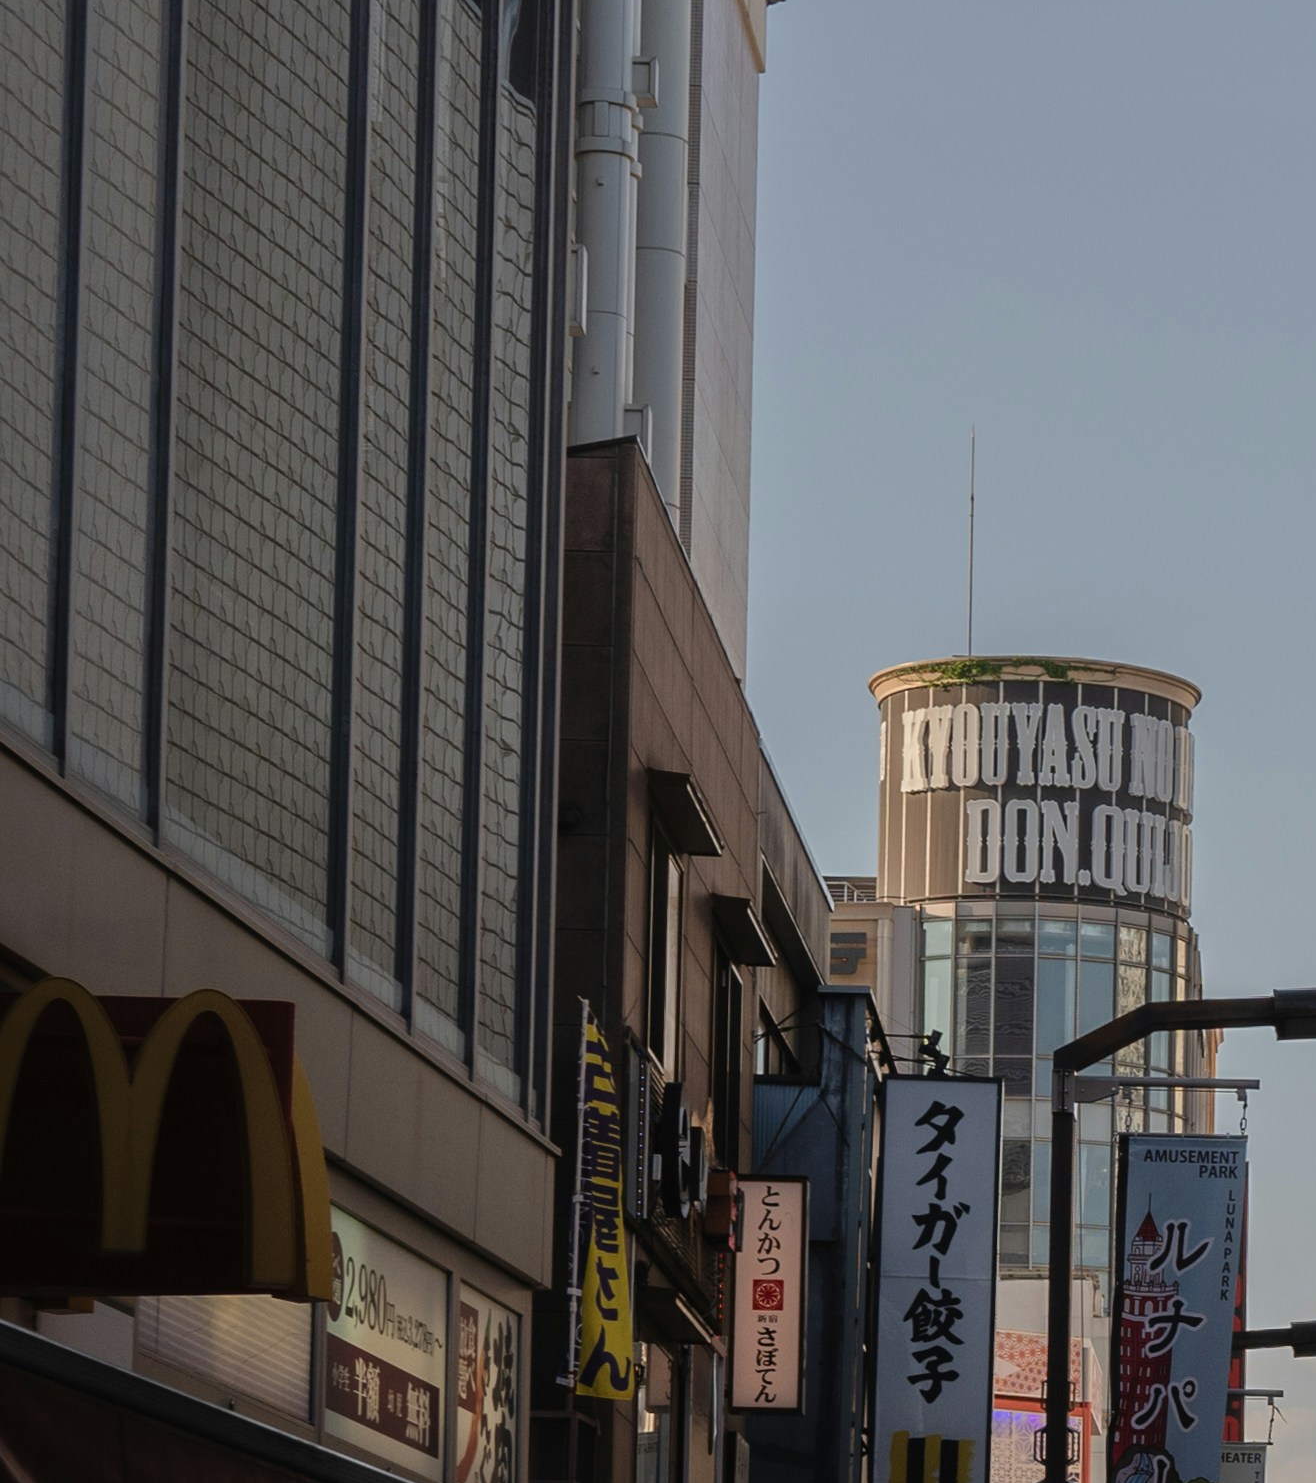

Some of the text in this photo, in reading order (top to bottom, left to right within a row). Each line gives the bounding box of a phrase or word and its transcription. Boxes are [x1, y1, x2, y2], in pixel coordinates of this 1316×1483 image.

[901, 701, 1126, 794] KYOUYASU
[1143, 1149, 1240, 1164] AMUSEMENT
[1199, 1165, 1238, 1179] PARK
[757, 1185, 782, 1276] とんかつ
[903, 1100, 971, 1404] タイガー餃子
[1220, 1190, 1236, 1301] LUNA PARK
[346, 1256, 395, 1340] 2,980円
[354, 1356, 381, 1424] 半額
[405, 1381, 431, 1448] 無料
[754, 1326, 778, 1404] さぼてん
[1221, 1452, 1262, 1464] HEATER
